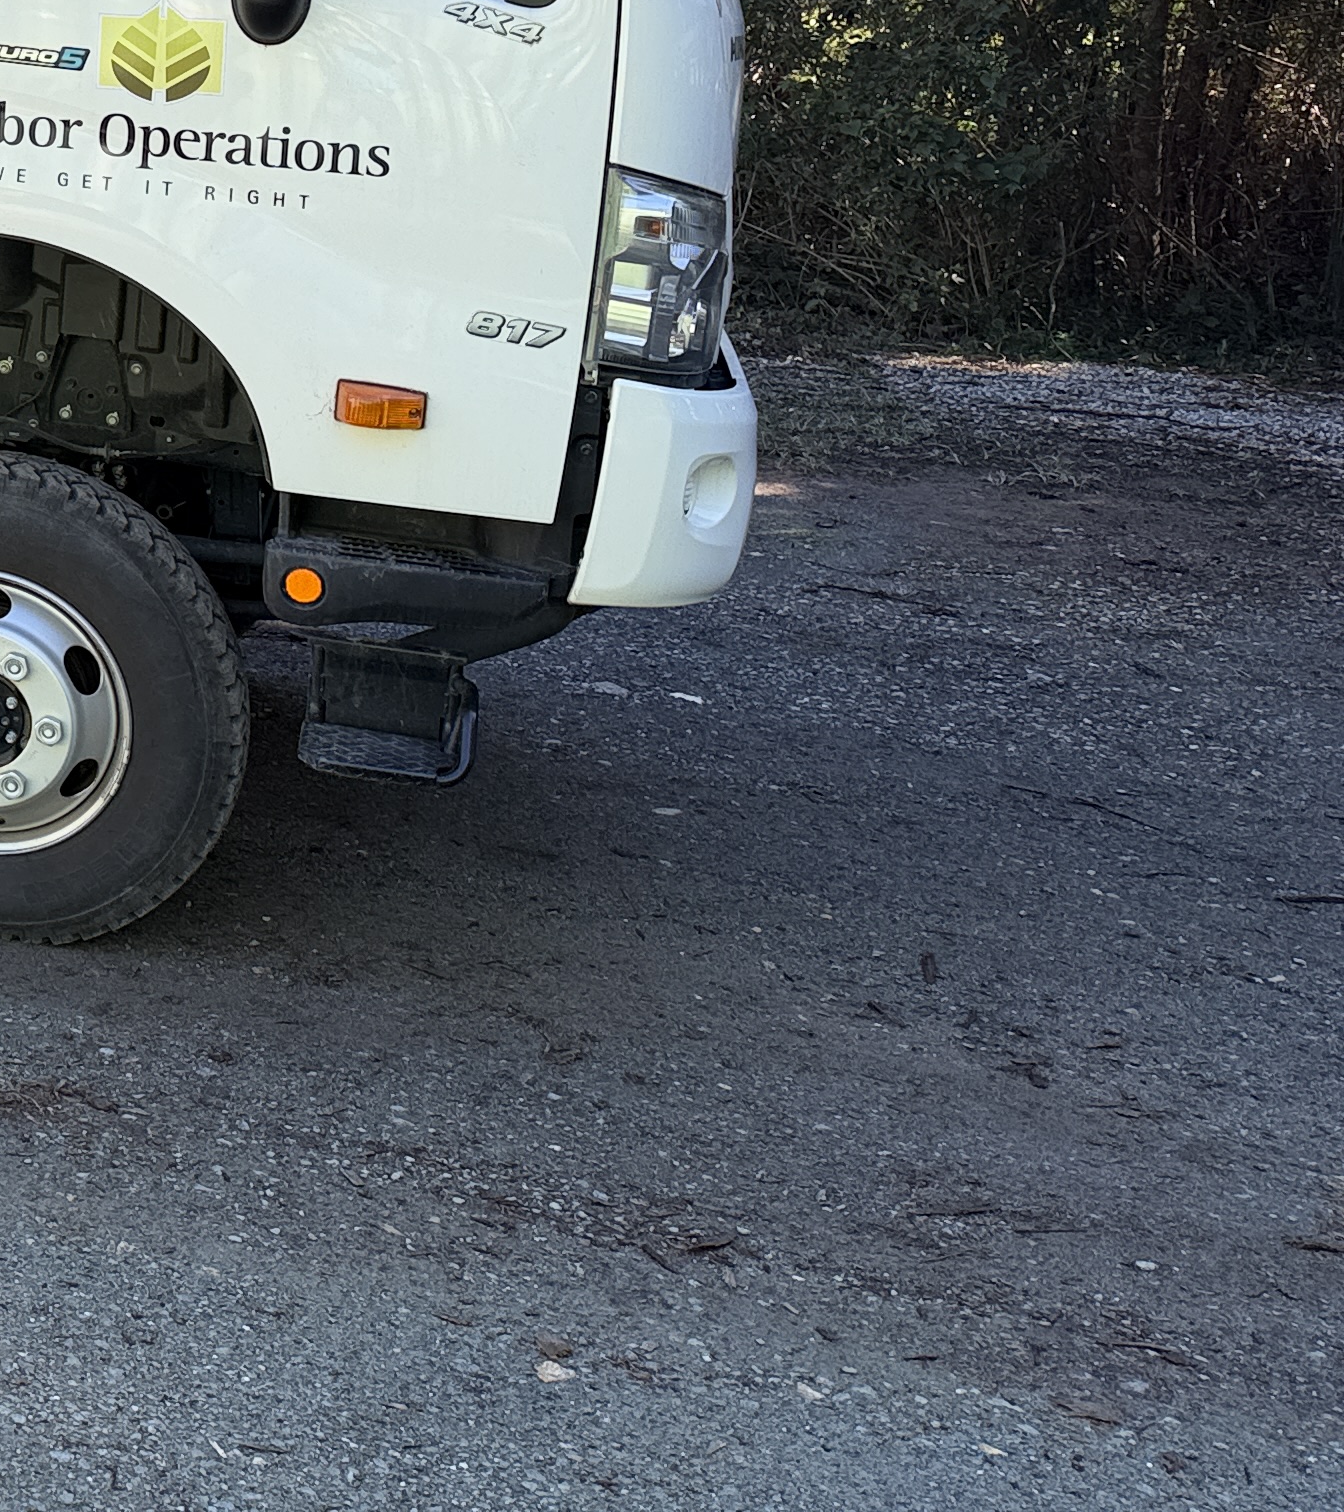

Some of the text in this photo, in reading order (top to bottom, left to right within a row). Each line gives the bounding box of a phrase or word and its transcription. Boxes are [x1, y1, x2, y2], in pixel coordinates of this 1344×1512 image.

[443, 2, 546, 46] 4X4
[99, 113, 392, 177] Operations
[57, 172, 113, 192] GET
[145, 179, 173, 197] IT
[205, 185, 311, 210] RIGHT
[466, 311, 567, 348] 817
